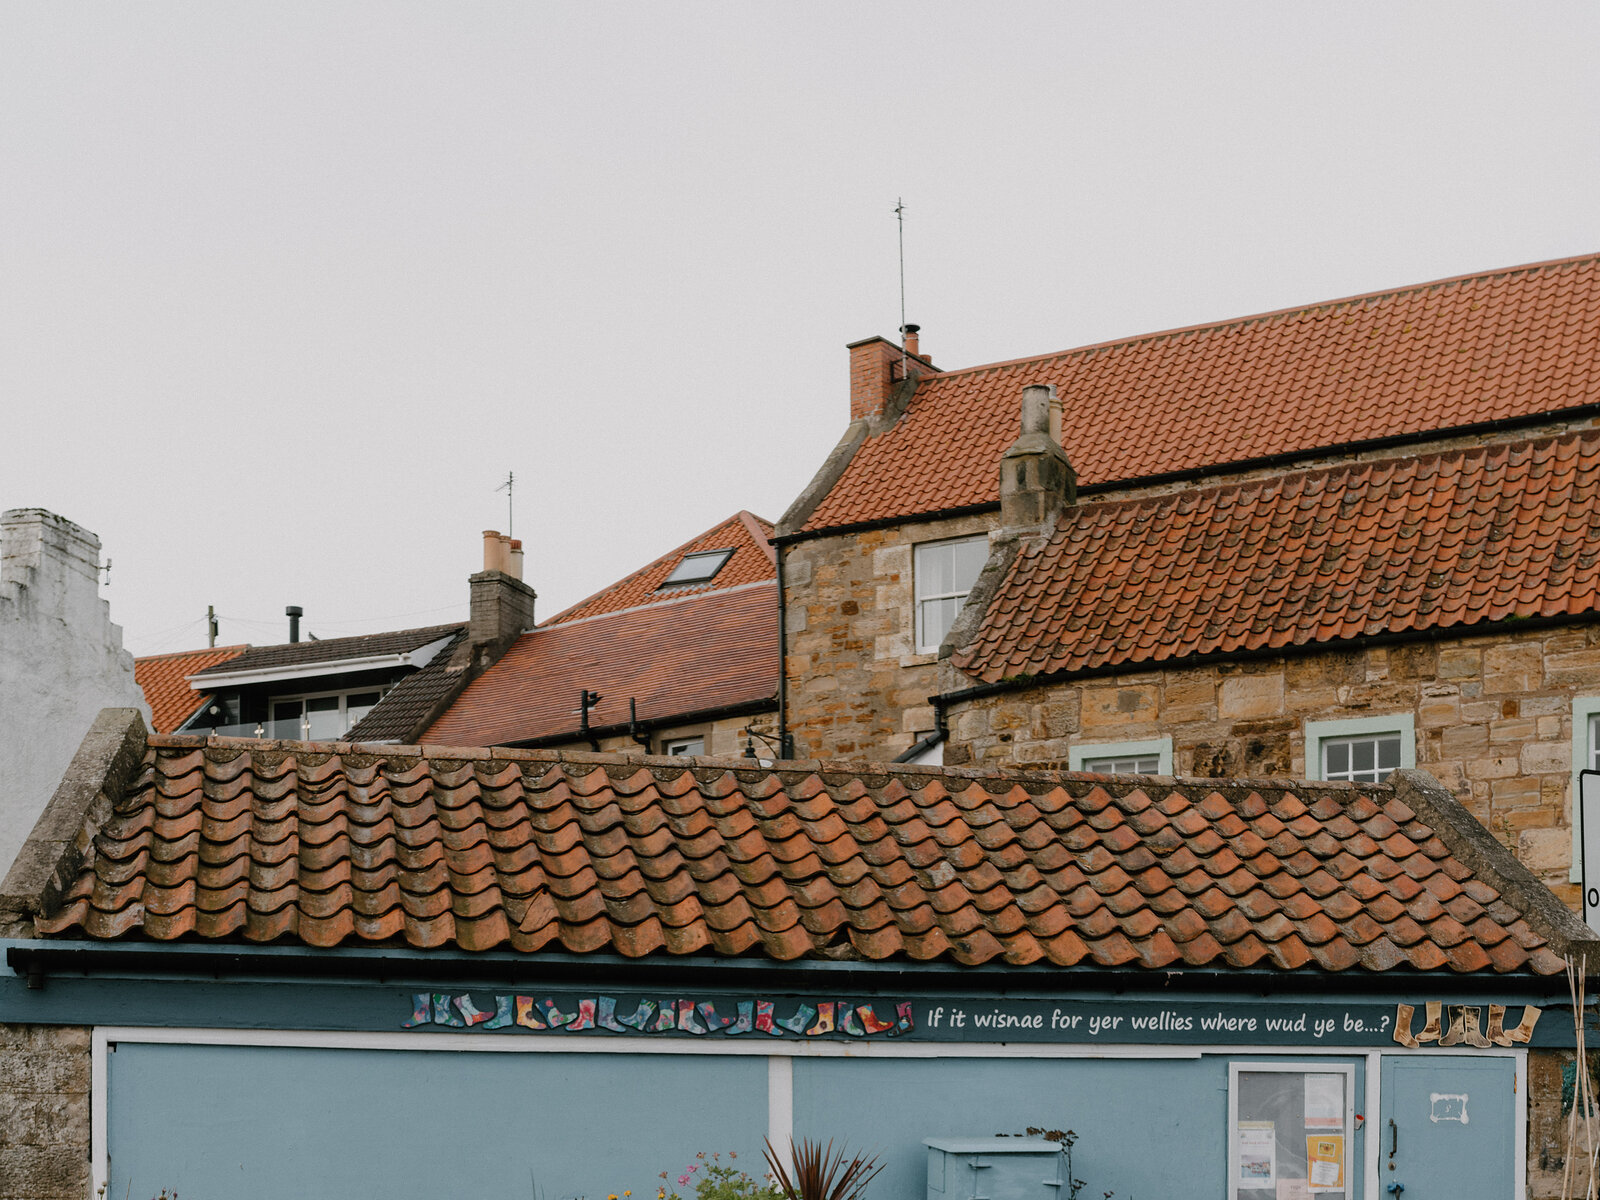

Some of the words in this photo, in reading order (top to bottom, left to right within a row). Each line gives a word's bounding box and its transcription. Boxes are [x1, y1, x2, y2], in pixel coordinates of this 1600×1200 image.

[927, 1006, 944, 1028] If
[949, 1008, 966, 1028] it
[974, 1009, 1043, 1029] wisnae
[1051, 1009, 1082, 1029] for
[1088, 1014, 1123, 1035] yer
[1131, 1010, 1193, 1031] wellies
[1200, 1012, 1257, 1032] where
[1265, 1013, 1307, 1032] wud
[1314, 1017, 1335, 1038] ye
